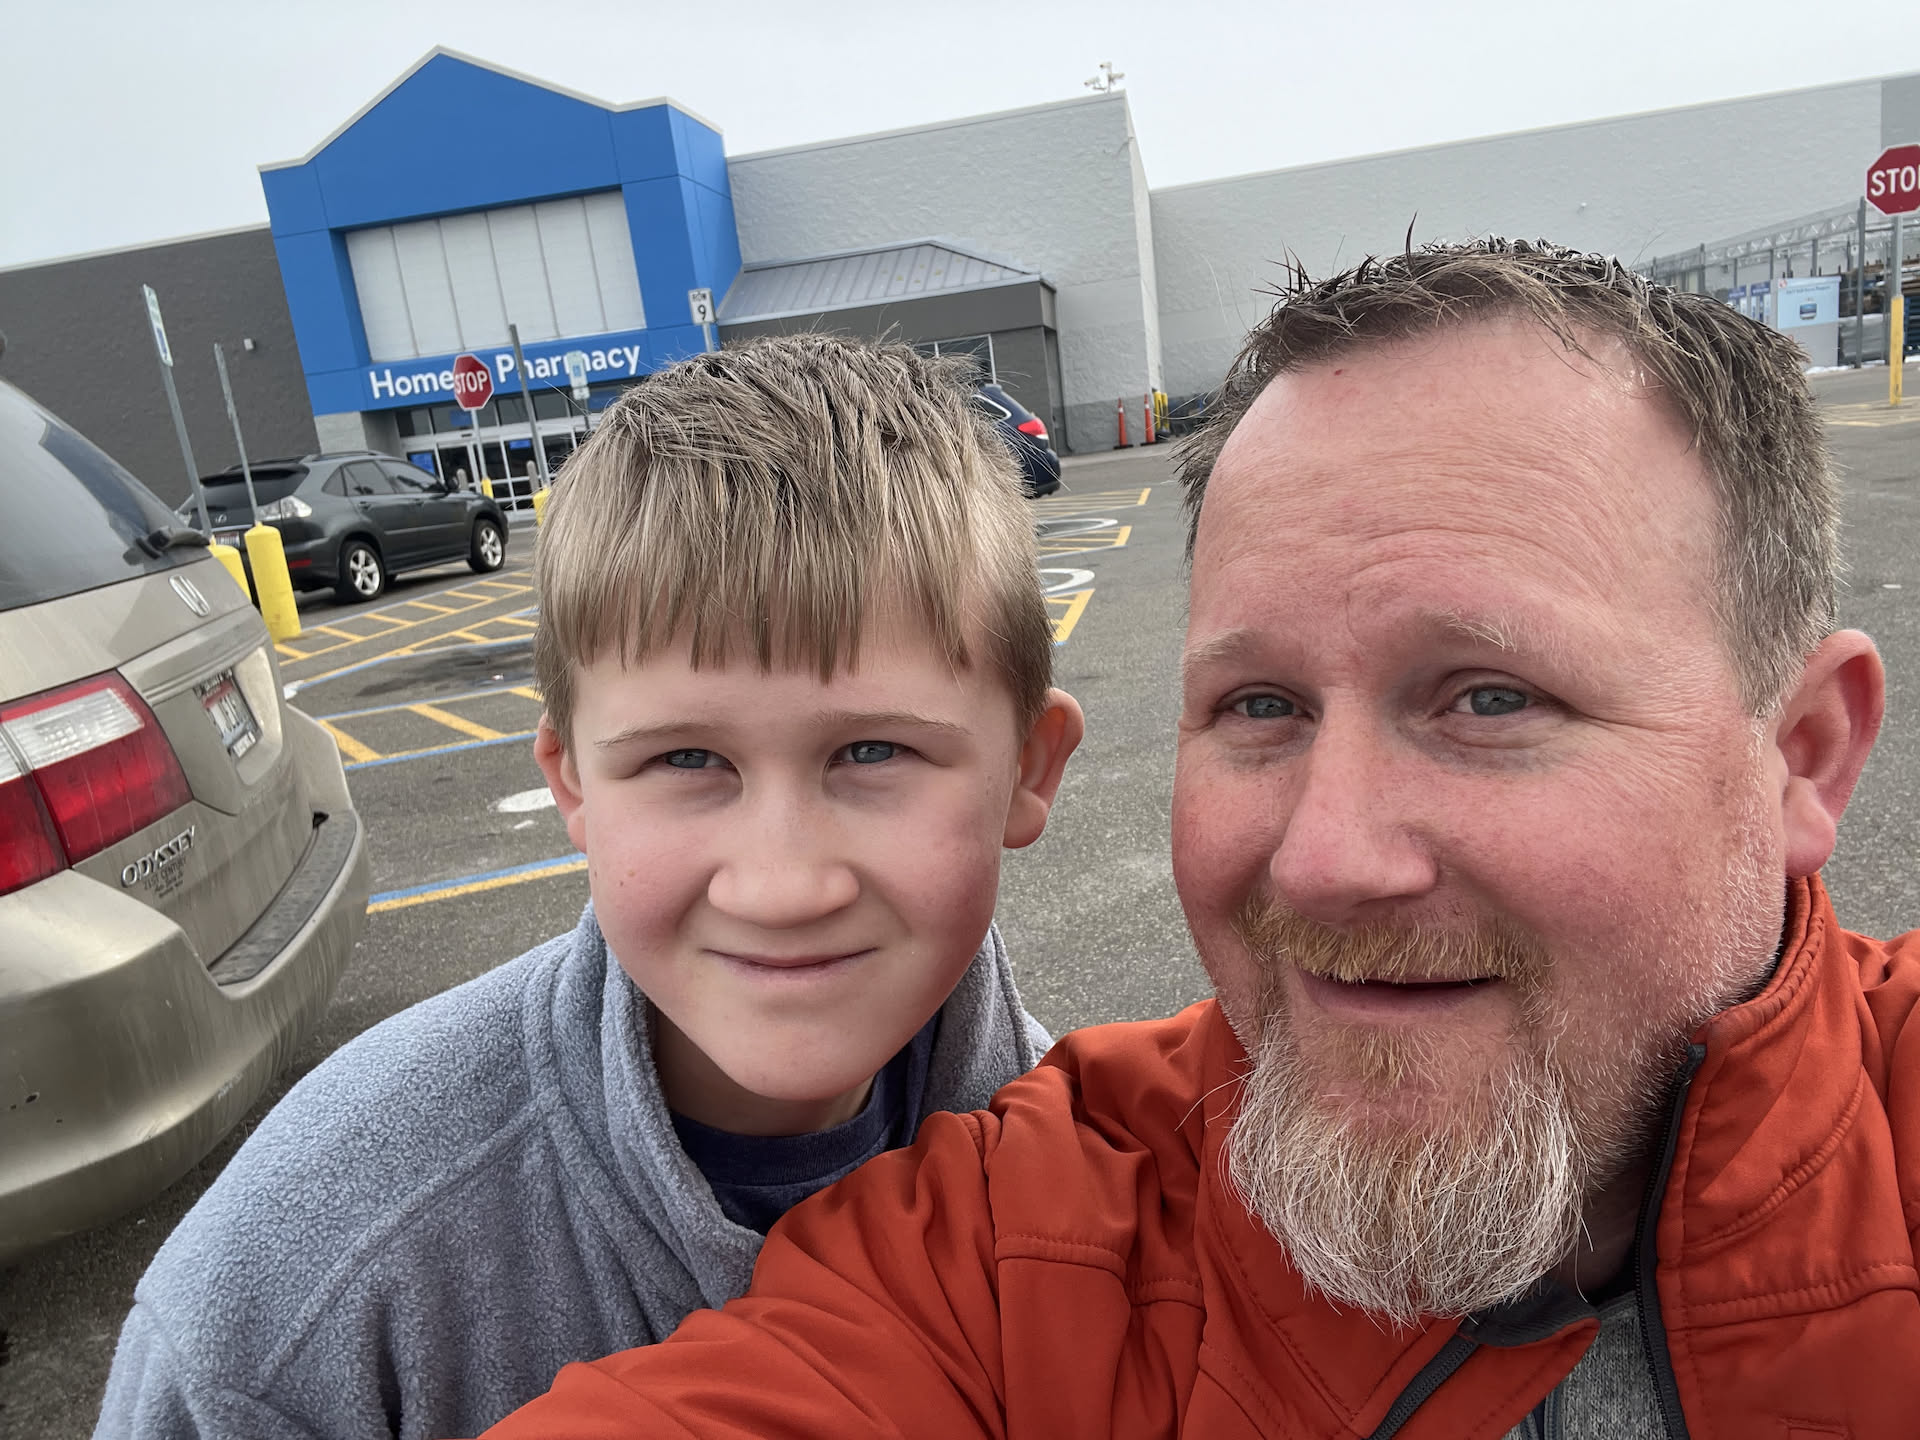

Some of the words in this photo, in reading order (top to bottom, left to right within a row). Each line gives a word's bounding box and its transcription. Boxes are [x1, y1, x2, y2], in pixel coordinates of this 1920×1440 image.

[1870, 164, 1920, 197] STO
[697, 304, 706, 321] 9
[369, 370, 454, 399] Home
[495, 345, 641, 384] Pharmacy
[454, 370, 488, 394] STOP
[121, 825, 195, 888] ODYSSEY
